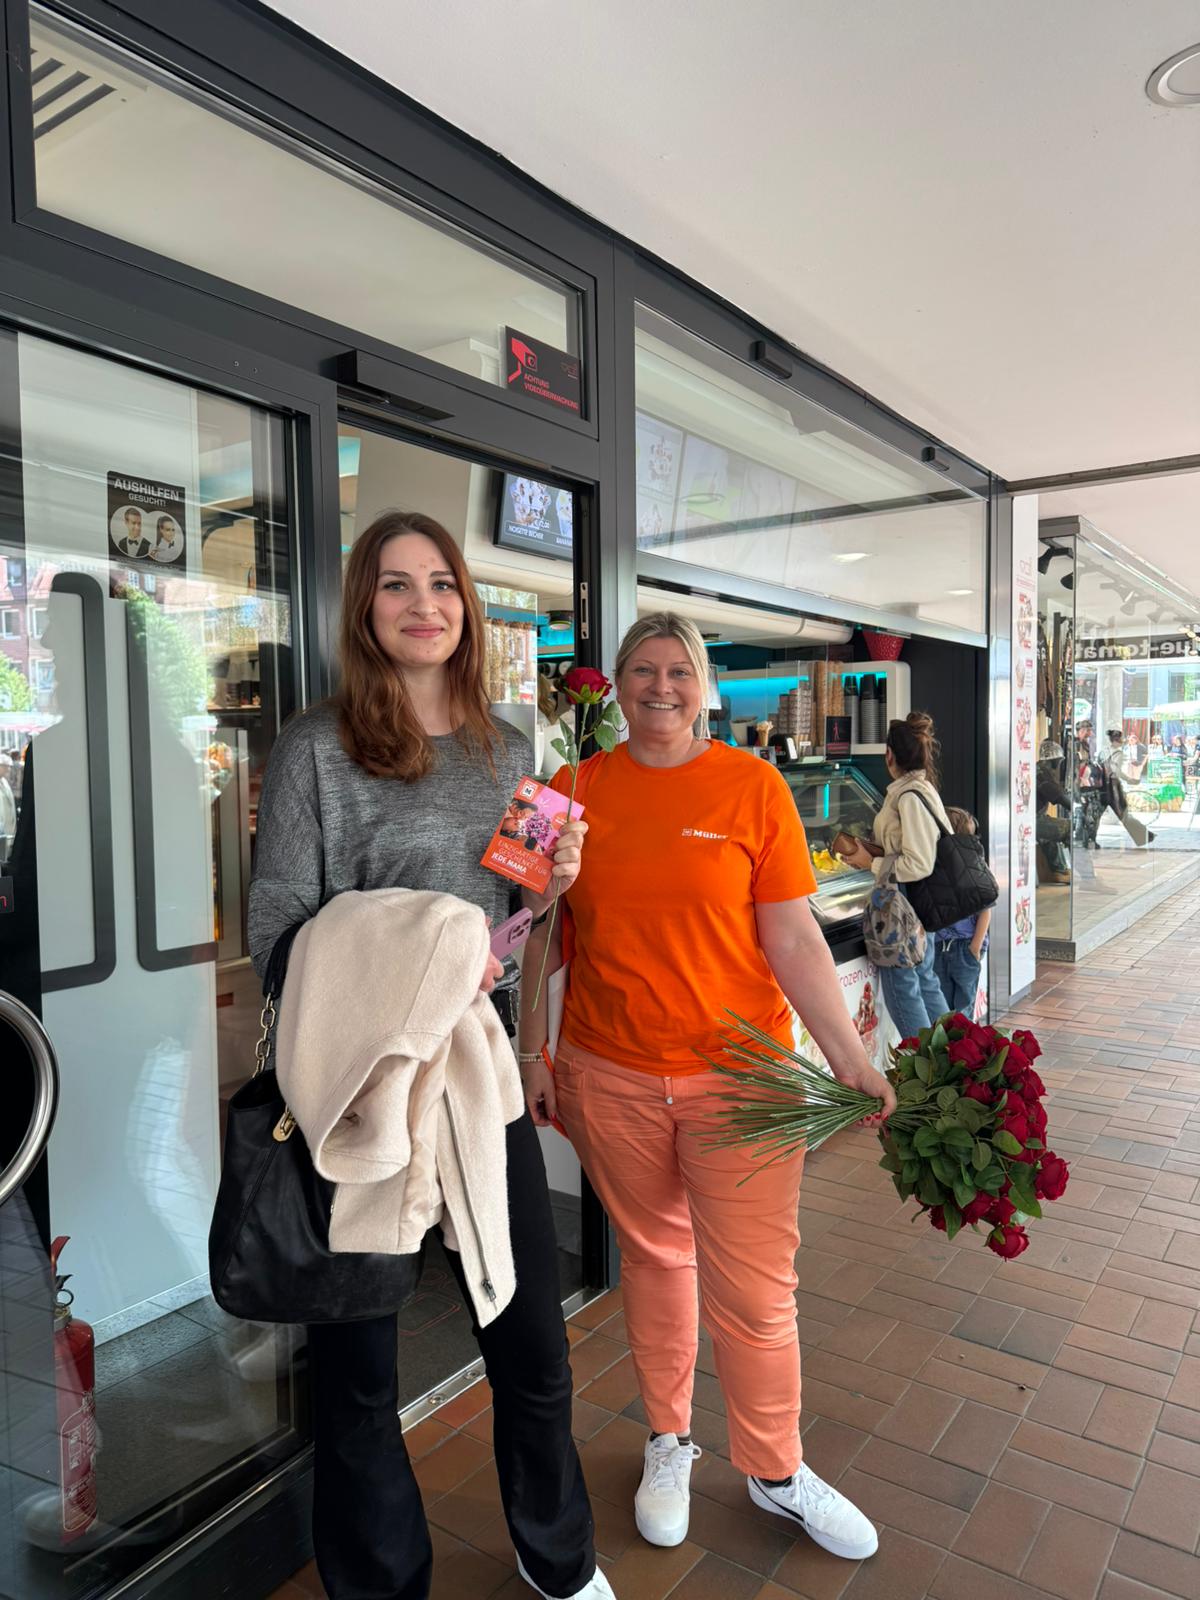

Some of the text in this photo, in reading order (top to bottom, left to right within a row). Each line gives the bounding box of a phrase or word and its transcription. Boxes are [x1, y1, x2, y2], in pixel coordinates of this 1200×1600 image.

[524, 373, 550, 389] ACHTUNG
[114, 479, 179, 500] AUSHILFEN
[128, 493, 166, 507] GESUCHT!
[491, 852, 527, 873] JEDE MAMA
